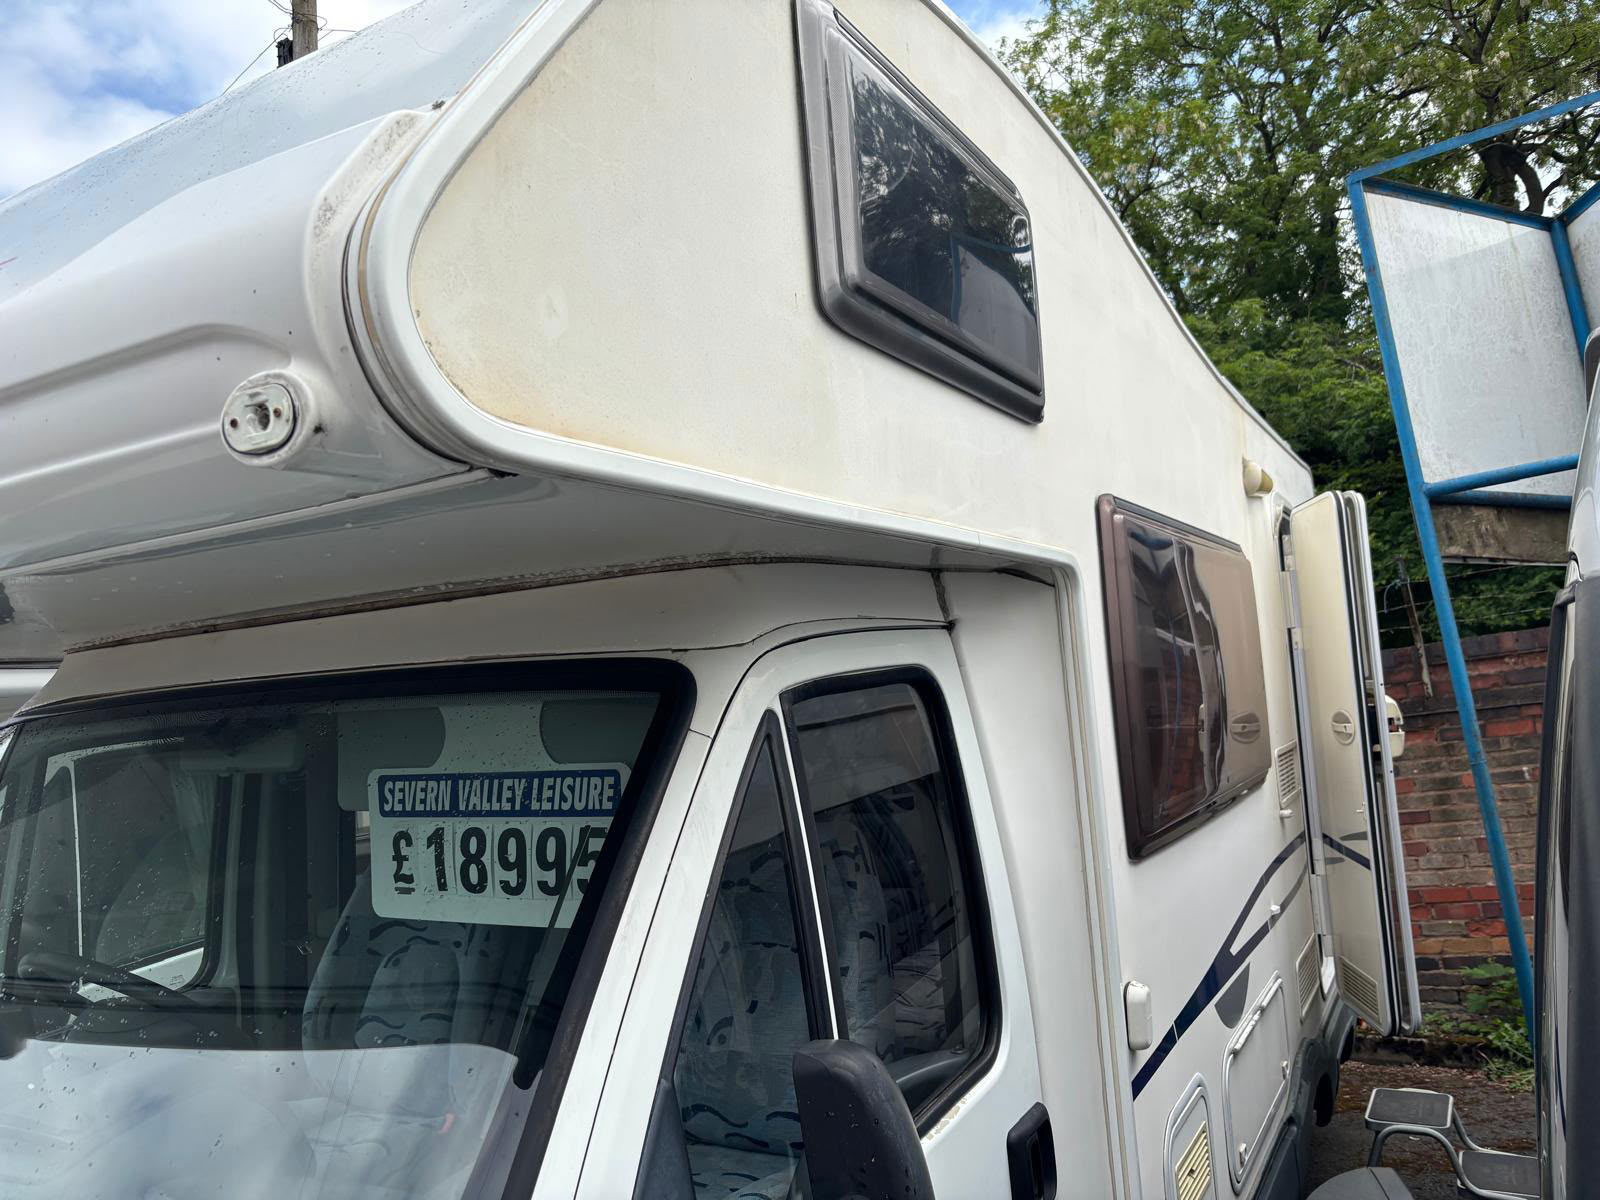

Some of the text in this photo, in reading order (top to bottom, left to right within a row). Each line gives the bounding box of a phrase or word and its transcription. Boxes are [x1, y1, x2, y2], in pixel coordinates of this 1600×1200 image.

[384, 776, 615, 812] SEVERN VALLEY LEISURE
